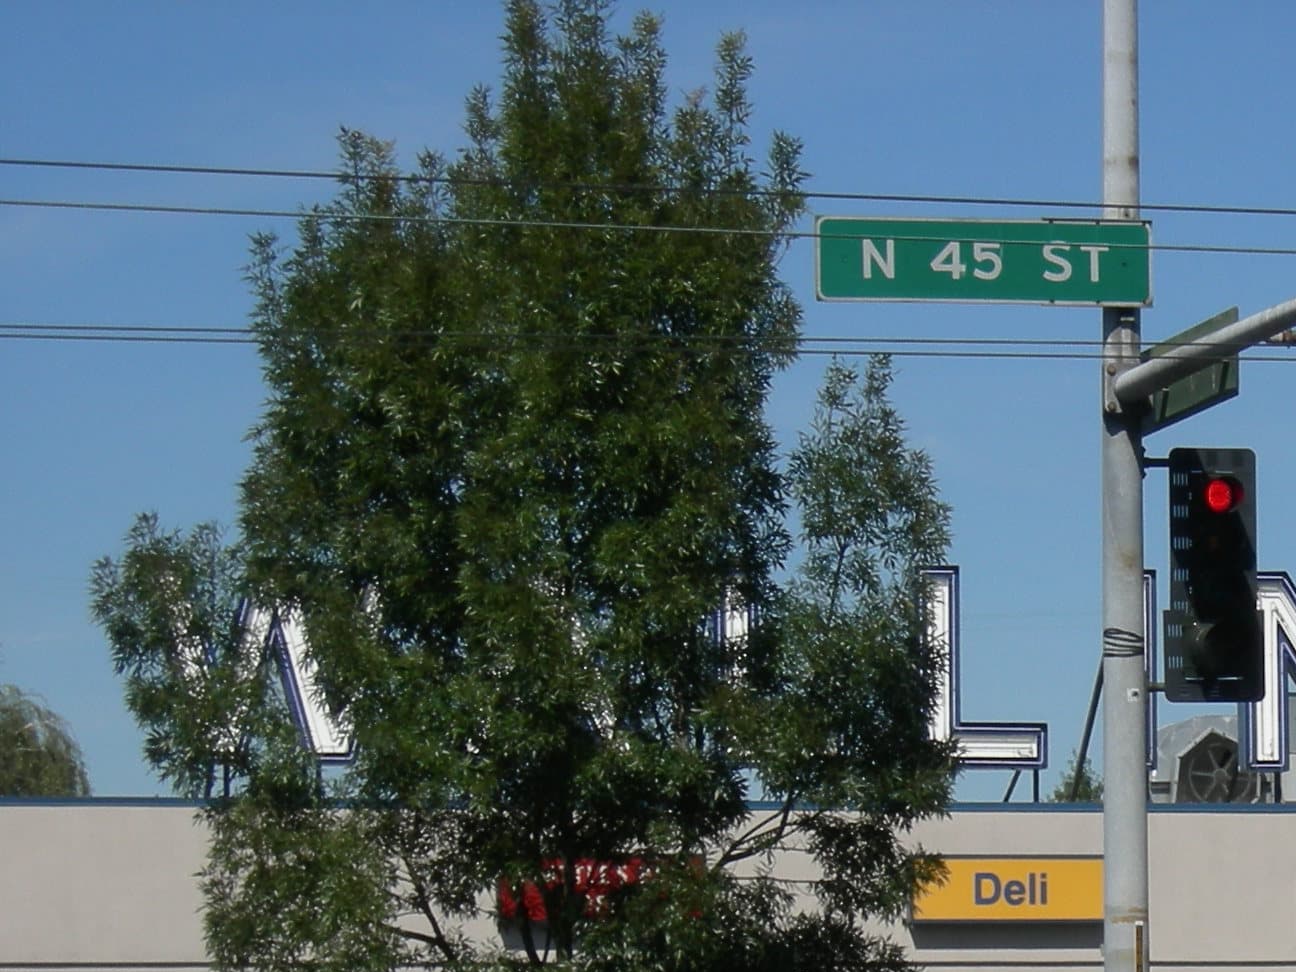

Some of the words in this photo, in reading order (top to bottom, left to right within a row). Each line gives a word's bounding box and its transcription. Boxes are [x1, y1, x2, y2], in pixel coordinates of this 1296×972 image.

[862, 239, 895, 280] N
[930, 241, 1002, 281] 45
[1042, 242, 1110, 283] ST
[974, 872, 1048, 906] Deli
